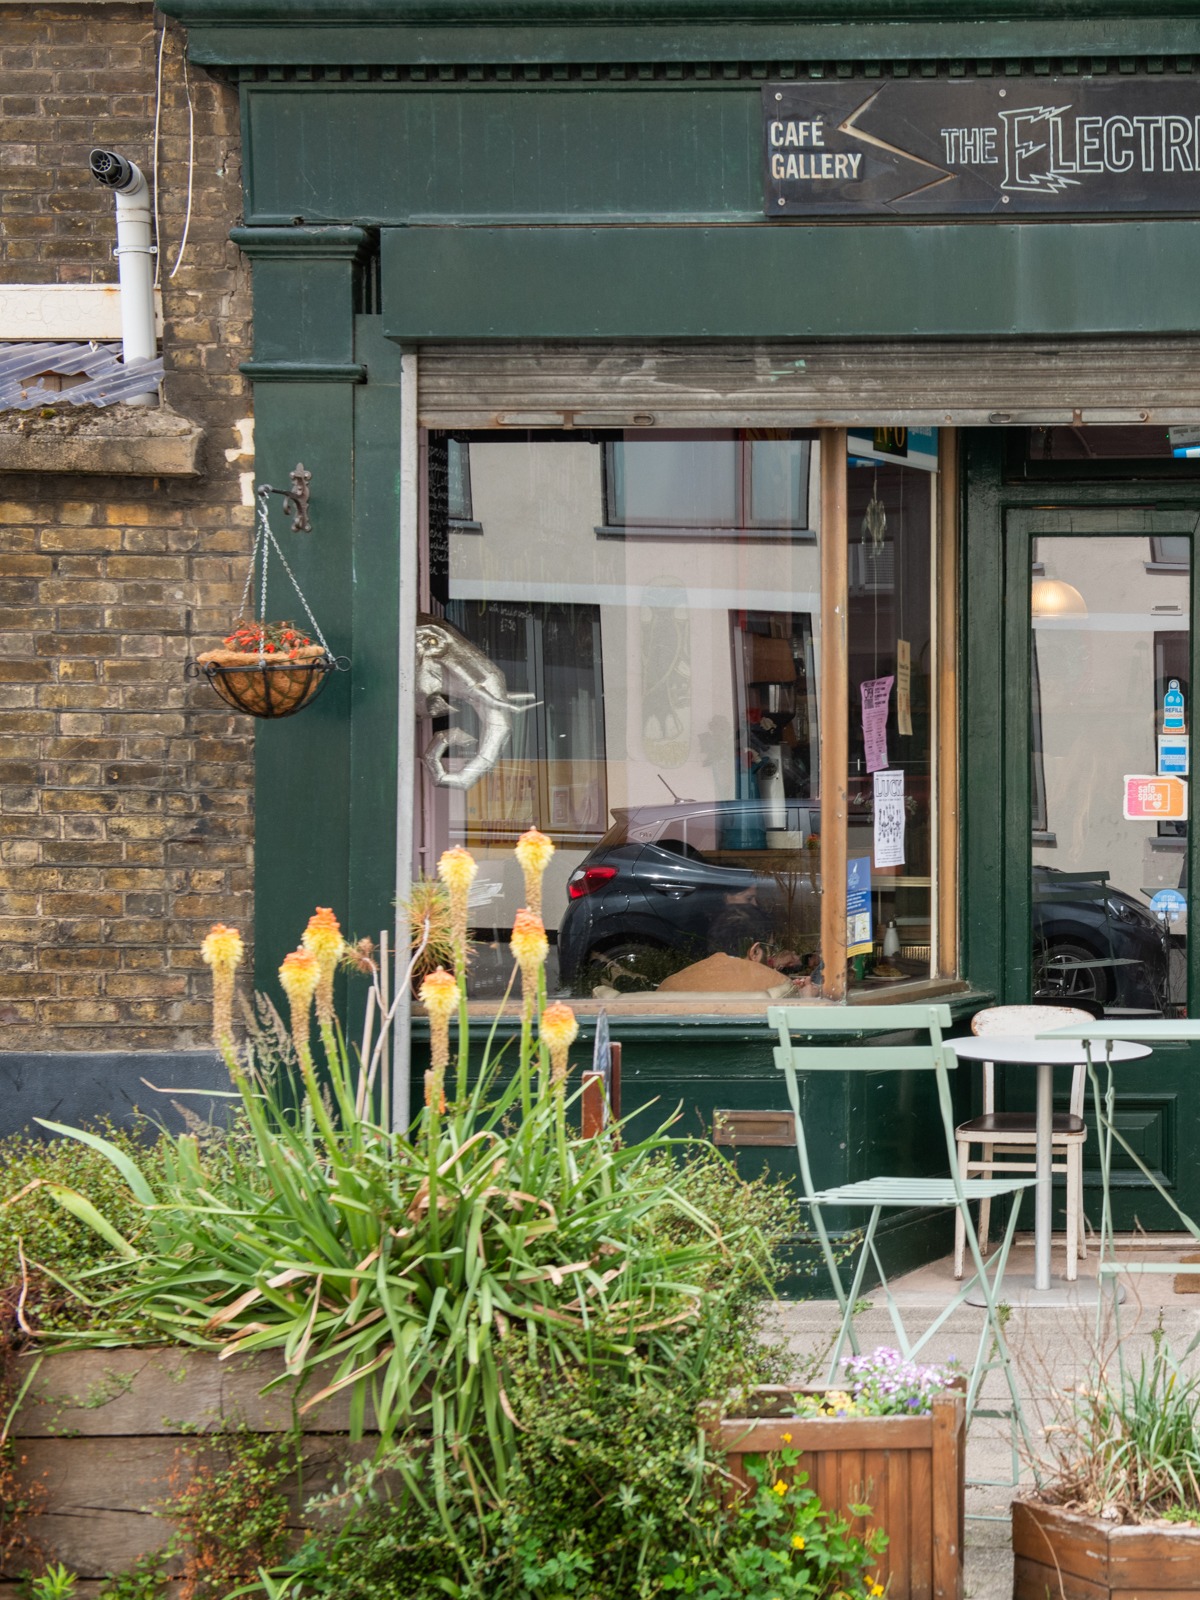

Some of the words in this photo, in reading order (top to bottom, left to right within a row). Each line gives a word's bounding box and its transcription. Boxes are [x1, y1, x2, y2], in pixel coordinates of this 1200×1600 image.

[770, 115, 825, 147] CAFÉ
[940, 127, 999, 165] THE
[771, 152, 862, 180] GALLERY
[1138, 784, 1156, 794] safe
[1138, 793, 1163, 801] space
